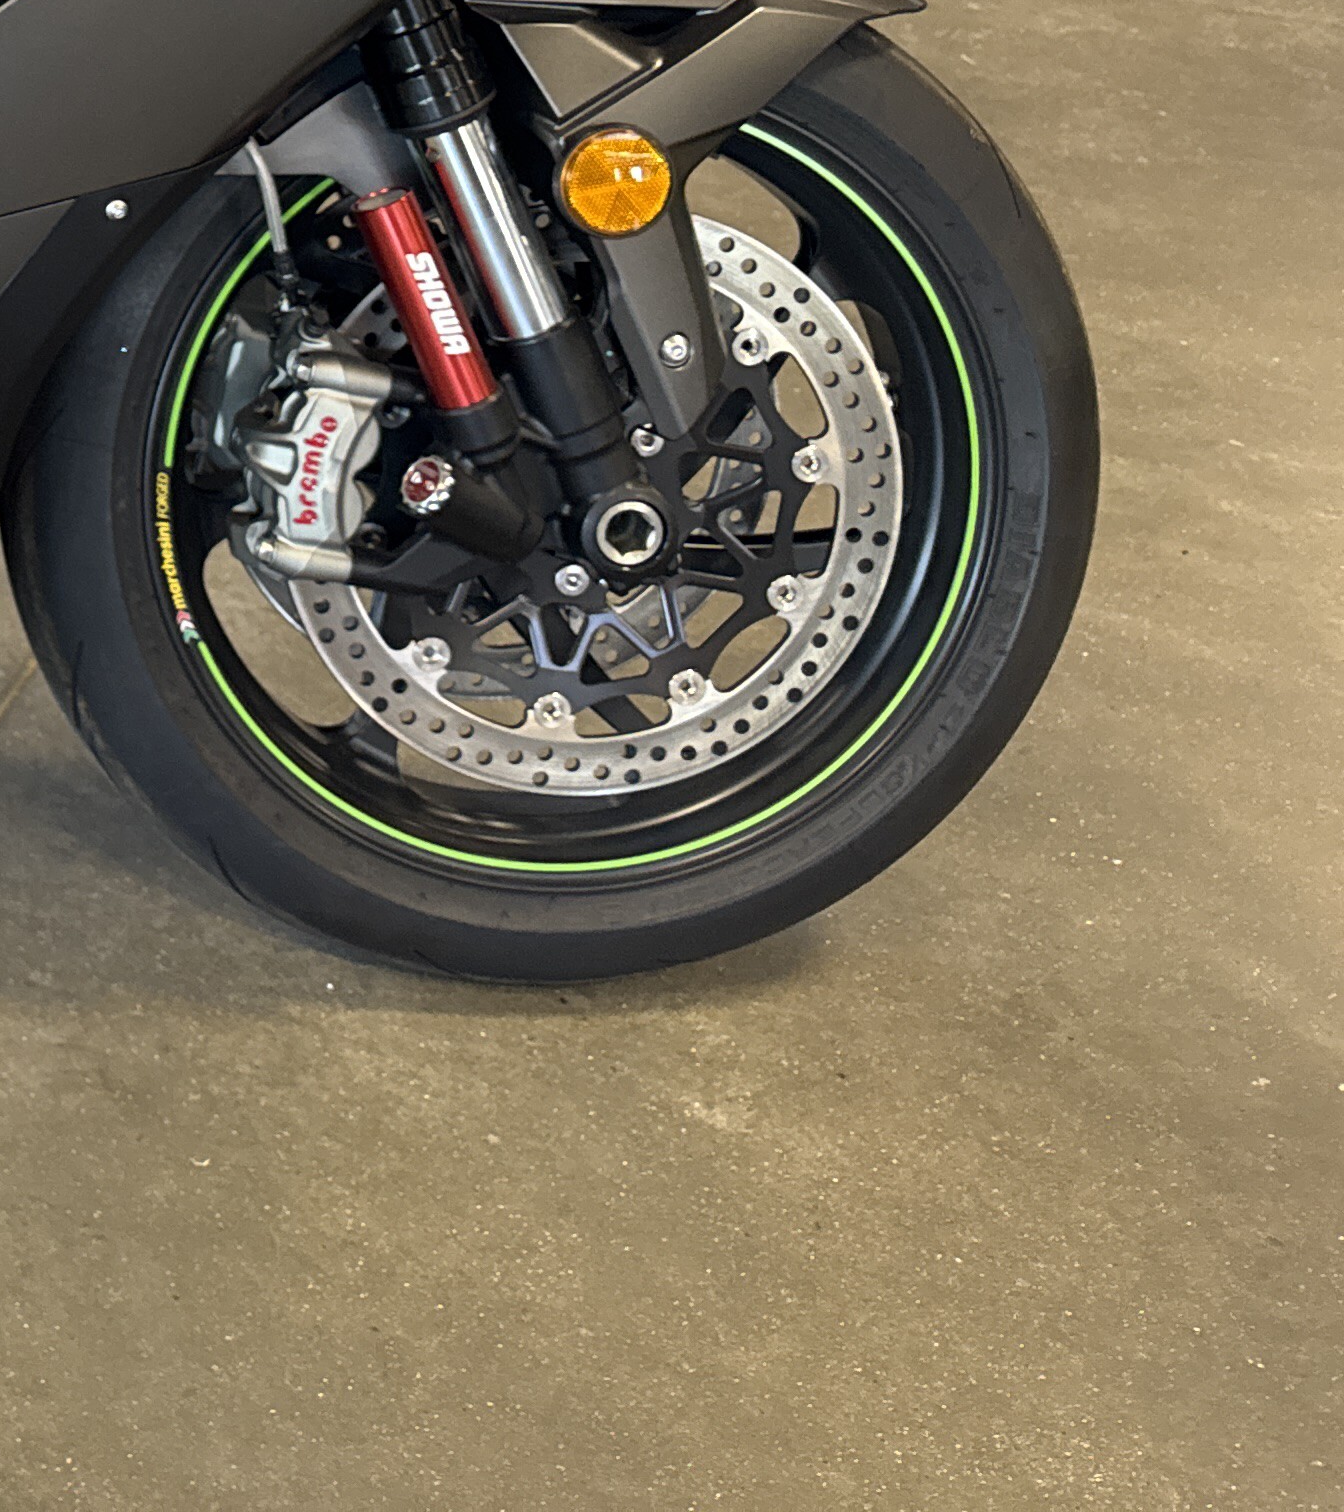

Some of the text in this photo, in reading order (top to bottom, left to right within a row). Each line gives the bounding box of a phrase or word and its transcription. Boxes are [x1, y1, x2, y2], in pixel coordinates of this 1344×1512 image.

[405, 251, 472, 357] SHOWA
[292, 415, 339, 526] brembo
[154, 471, 188, 610] marchesini FORGED
